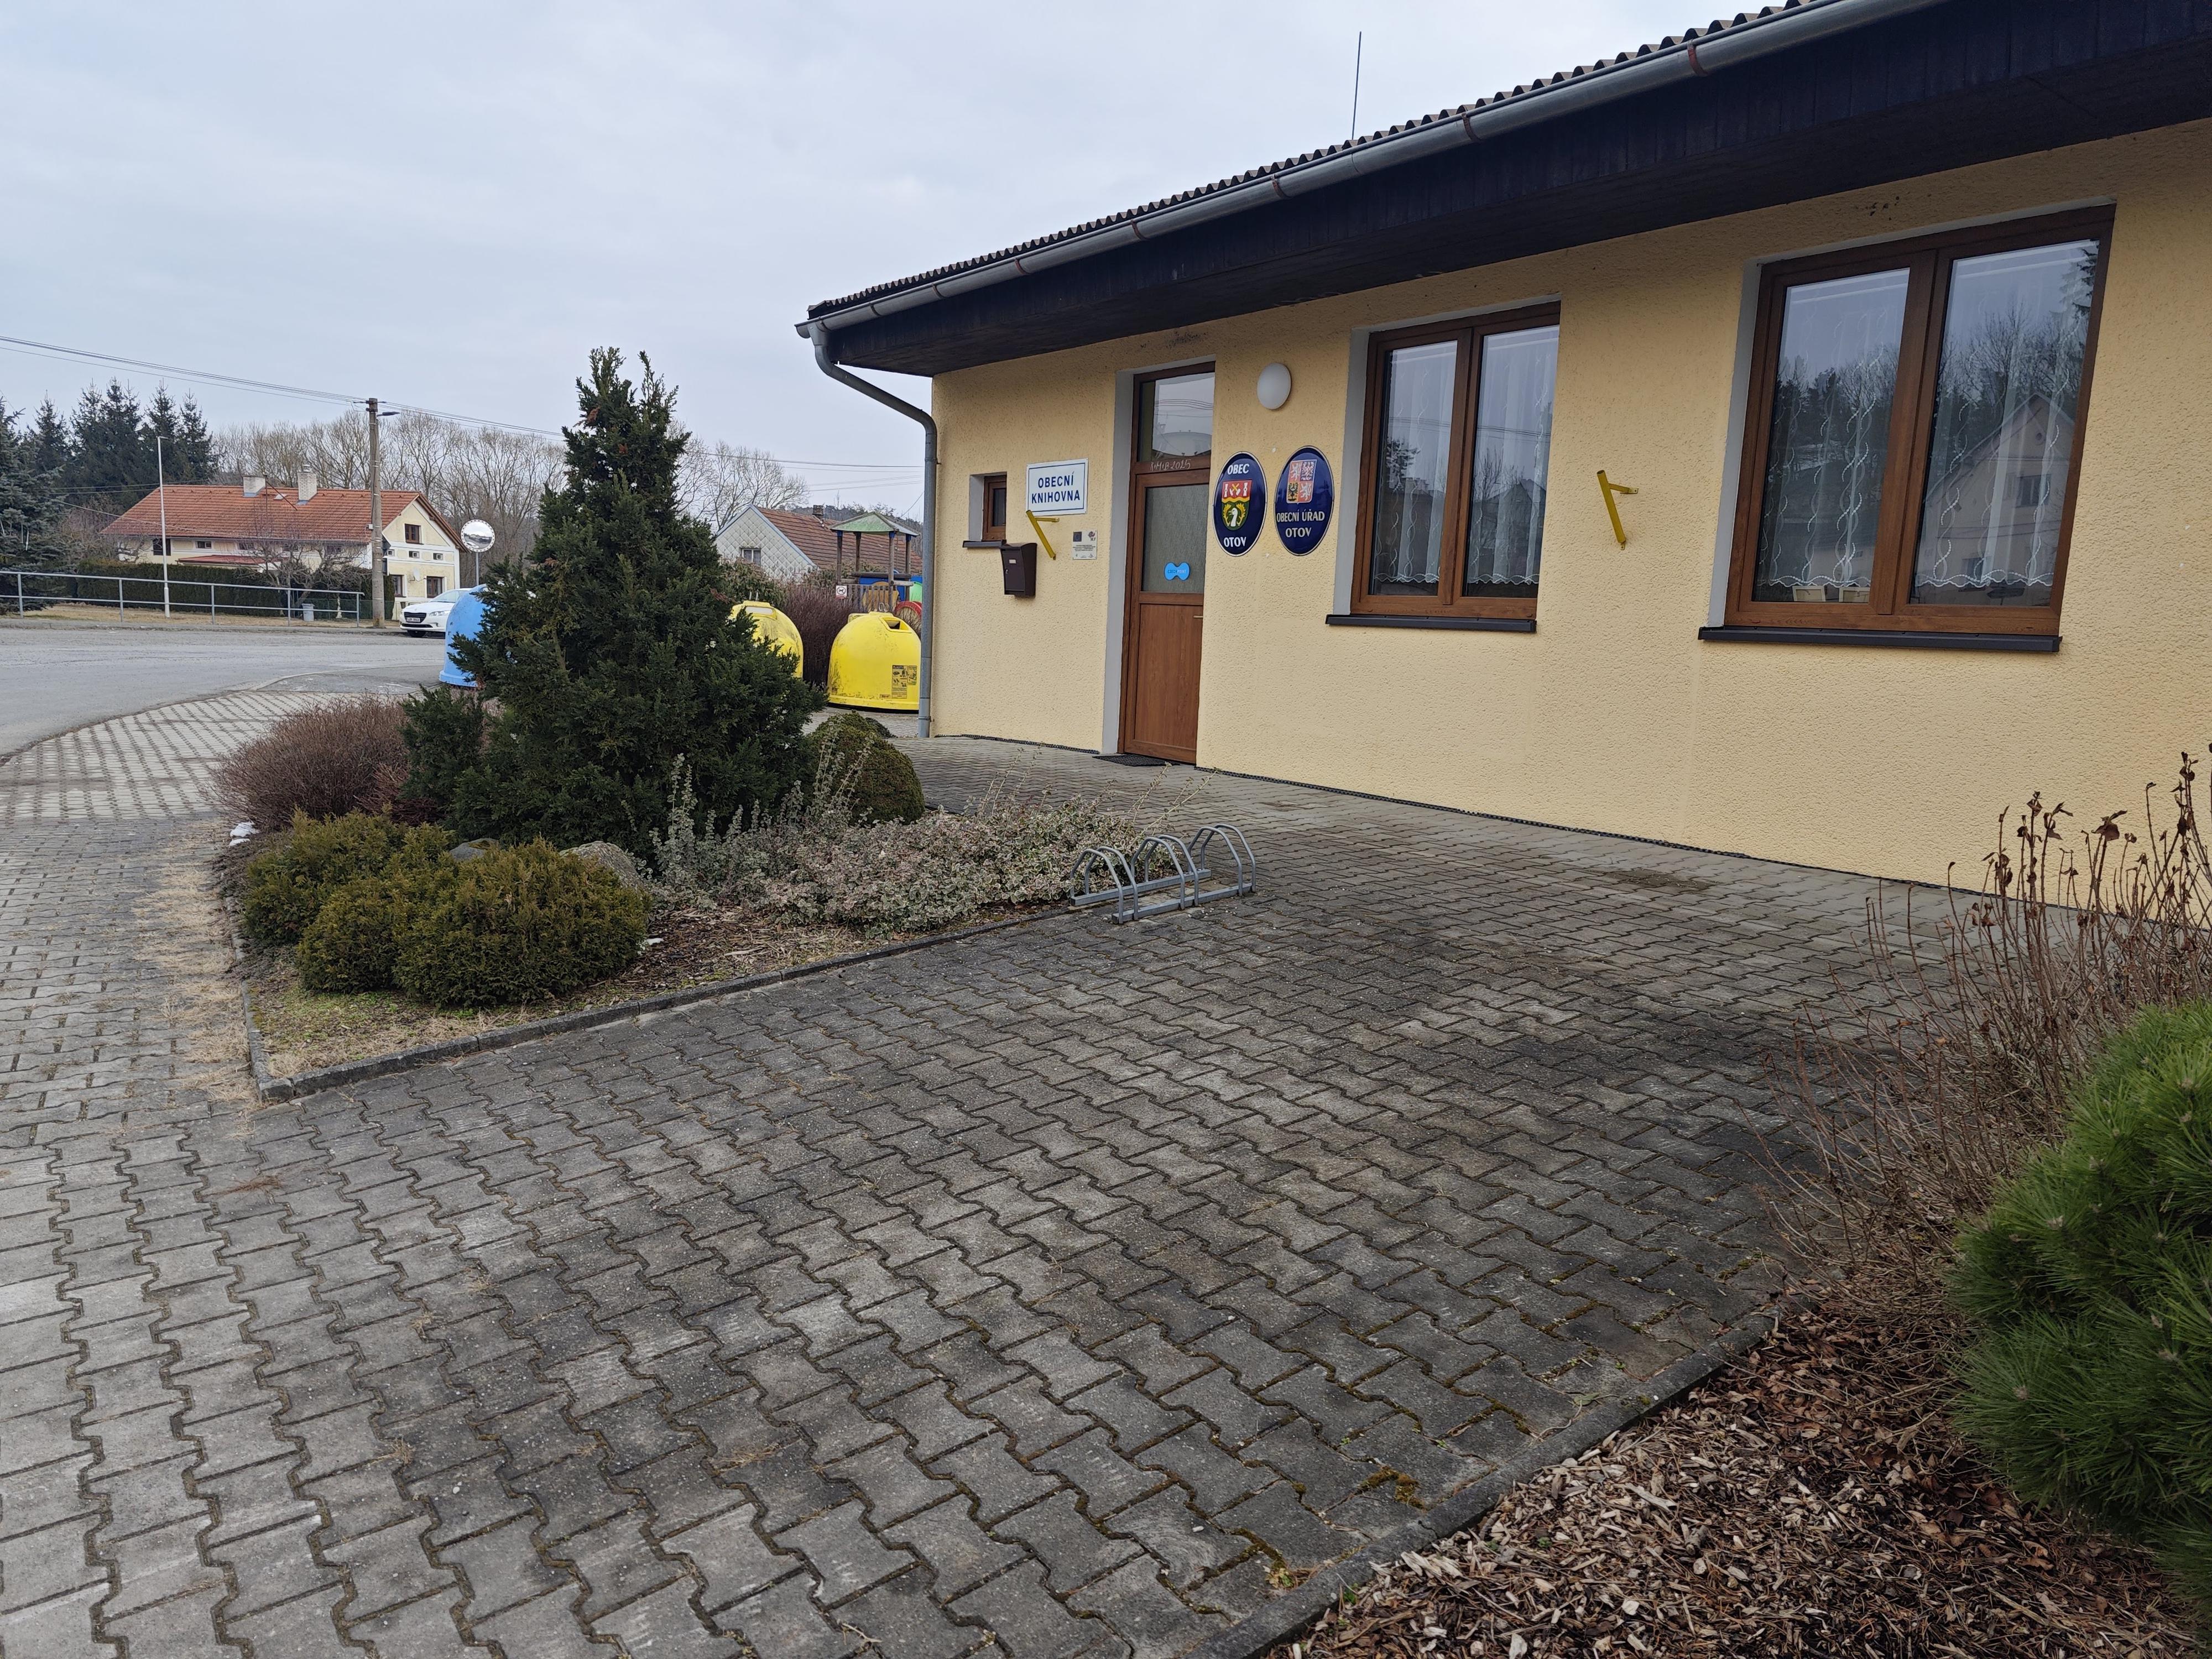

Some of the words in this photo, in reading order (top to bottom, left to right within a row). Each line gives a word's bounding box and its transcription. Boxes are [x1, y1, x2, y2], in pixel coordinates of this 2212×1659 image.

[1171, 459, 1191, 469] 2025
[1227, 463, 1250, 475] OBEC
[1038, 471, 1074, 488] OBECNÍ
[1031, 489, 1080, 504] KNIHOVNA
[1276, 509, 1300, 523] OBECNÍ
[1302, 508, 1325, 521] ÚŘAD
[1285, 526, 1312, 538] OTOV
[1223, 536, 1246, 547] OTOV
